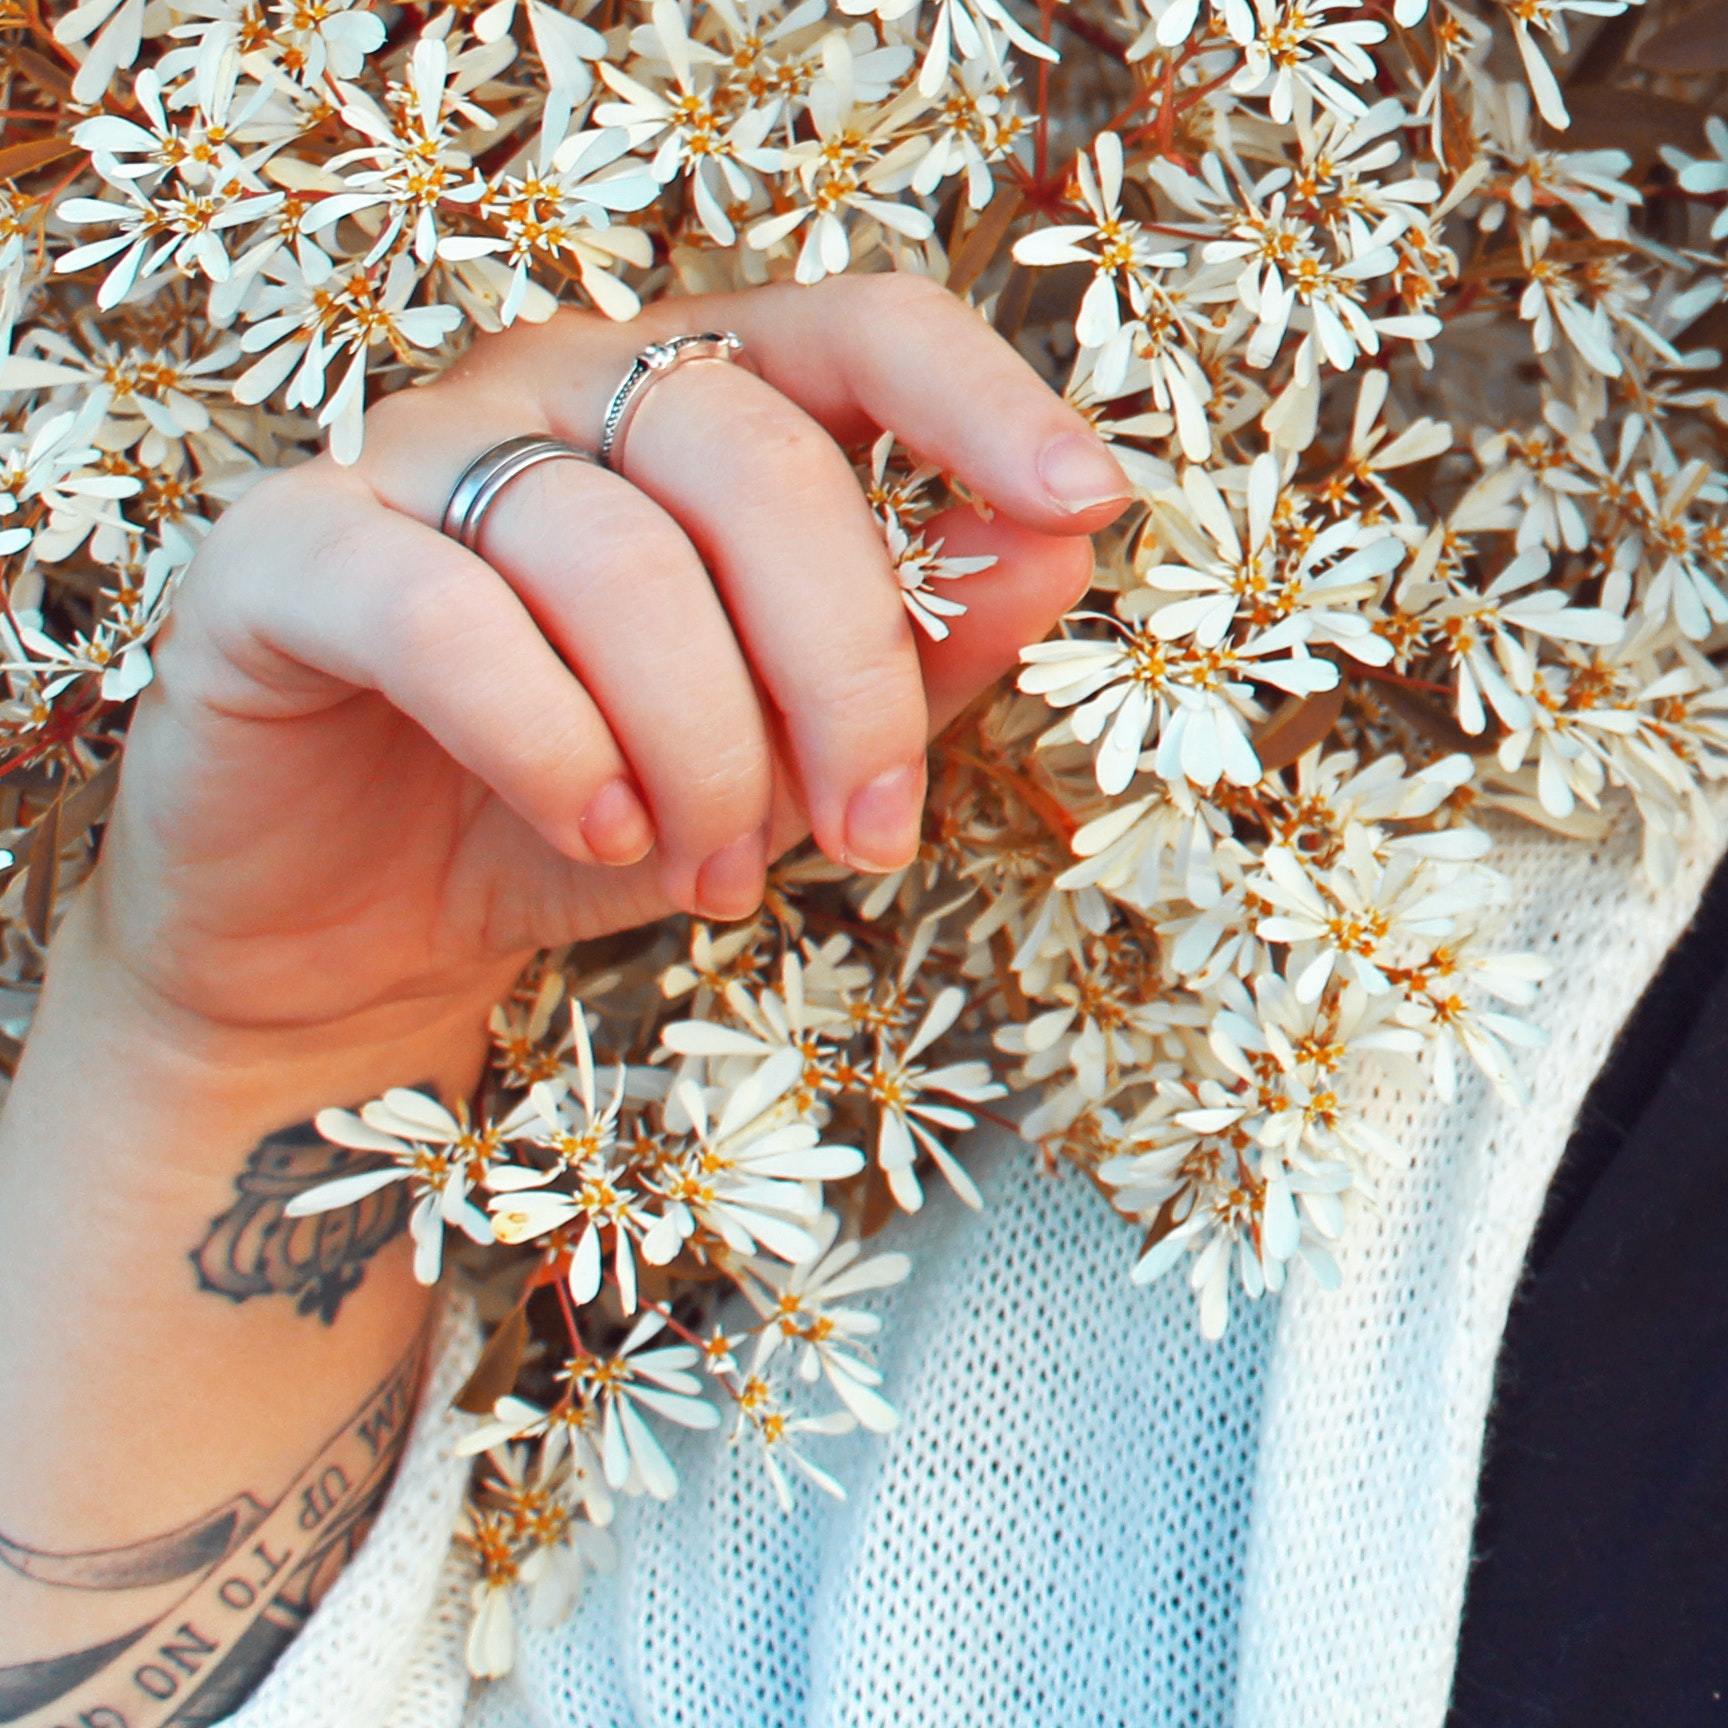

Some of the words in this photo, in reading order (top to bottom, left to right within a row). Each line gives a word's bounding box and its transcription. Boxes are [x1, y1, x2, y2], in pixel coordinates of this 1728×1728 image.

[299, 1467, 351, 1530] UP
[218, 1540, 293, 1610] TO
[133, 1622, 220, 1701] NO
